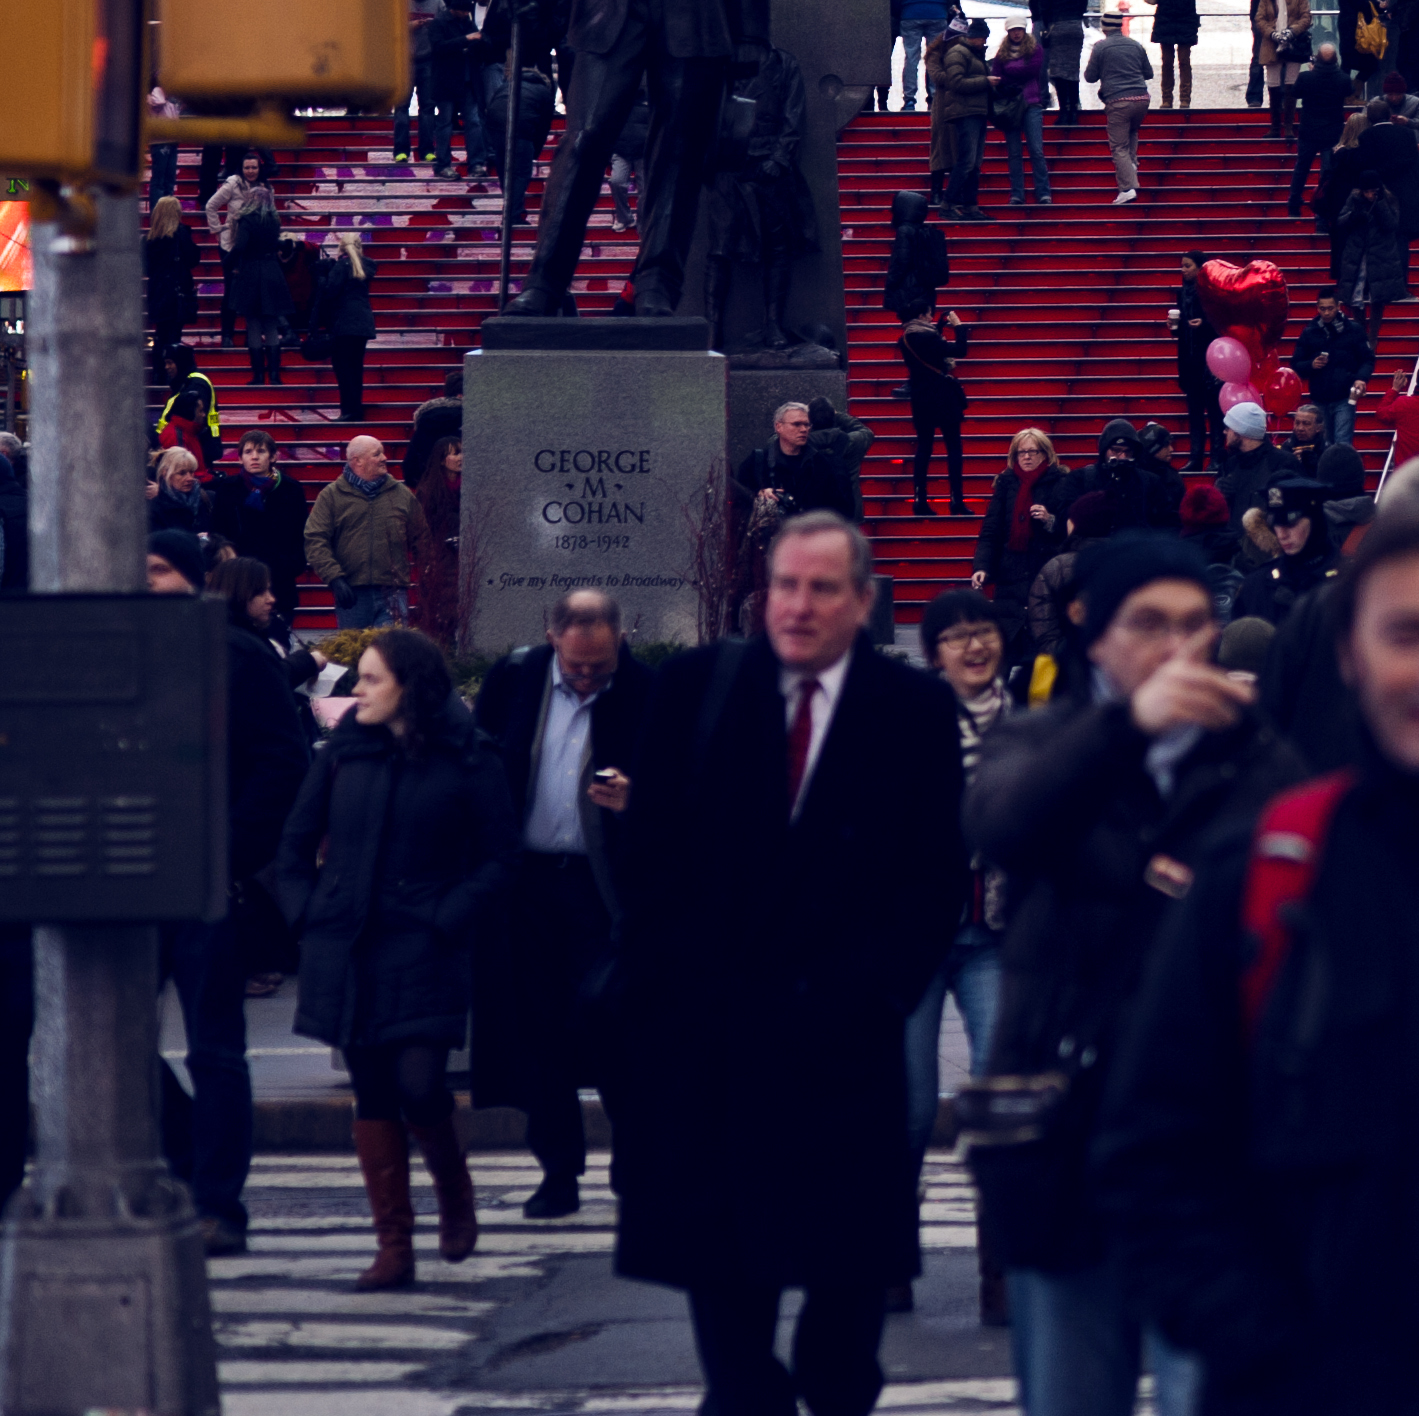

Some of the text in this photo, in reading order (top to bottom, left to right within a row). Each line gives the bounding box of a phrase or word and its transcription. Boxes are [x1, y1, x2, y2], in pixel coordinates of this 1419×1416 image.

[533, 449, 651, 474] GEORGE
[581, 477, 609, 499] M
[542, 501, 645, 525] COHAN
[554, 534, 630, 552] 1878-1942
[498, 572, 686, 592] Give my Regards to Broadway
